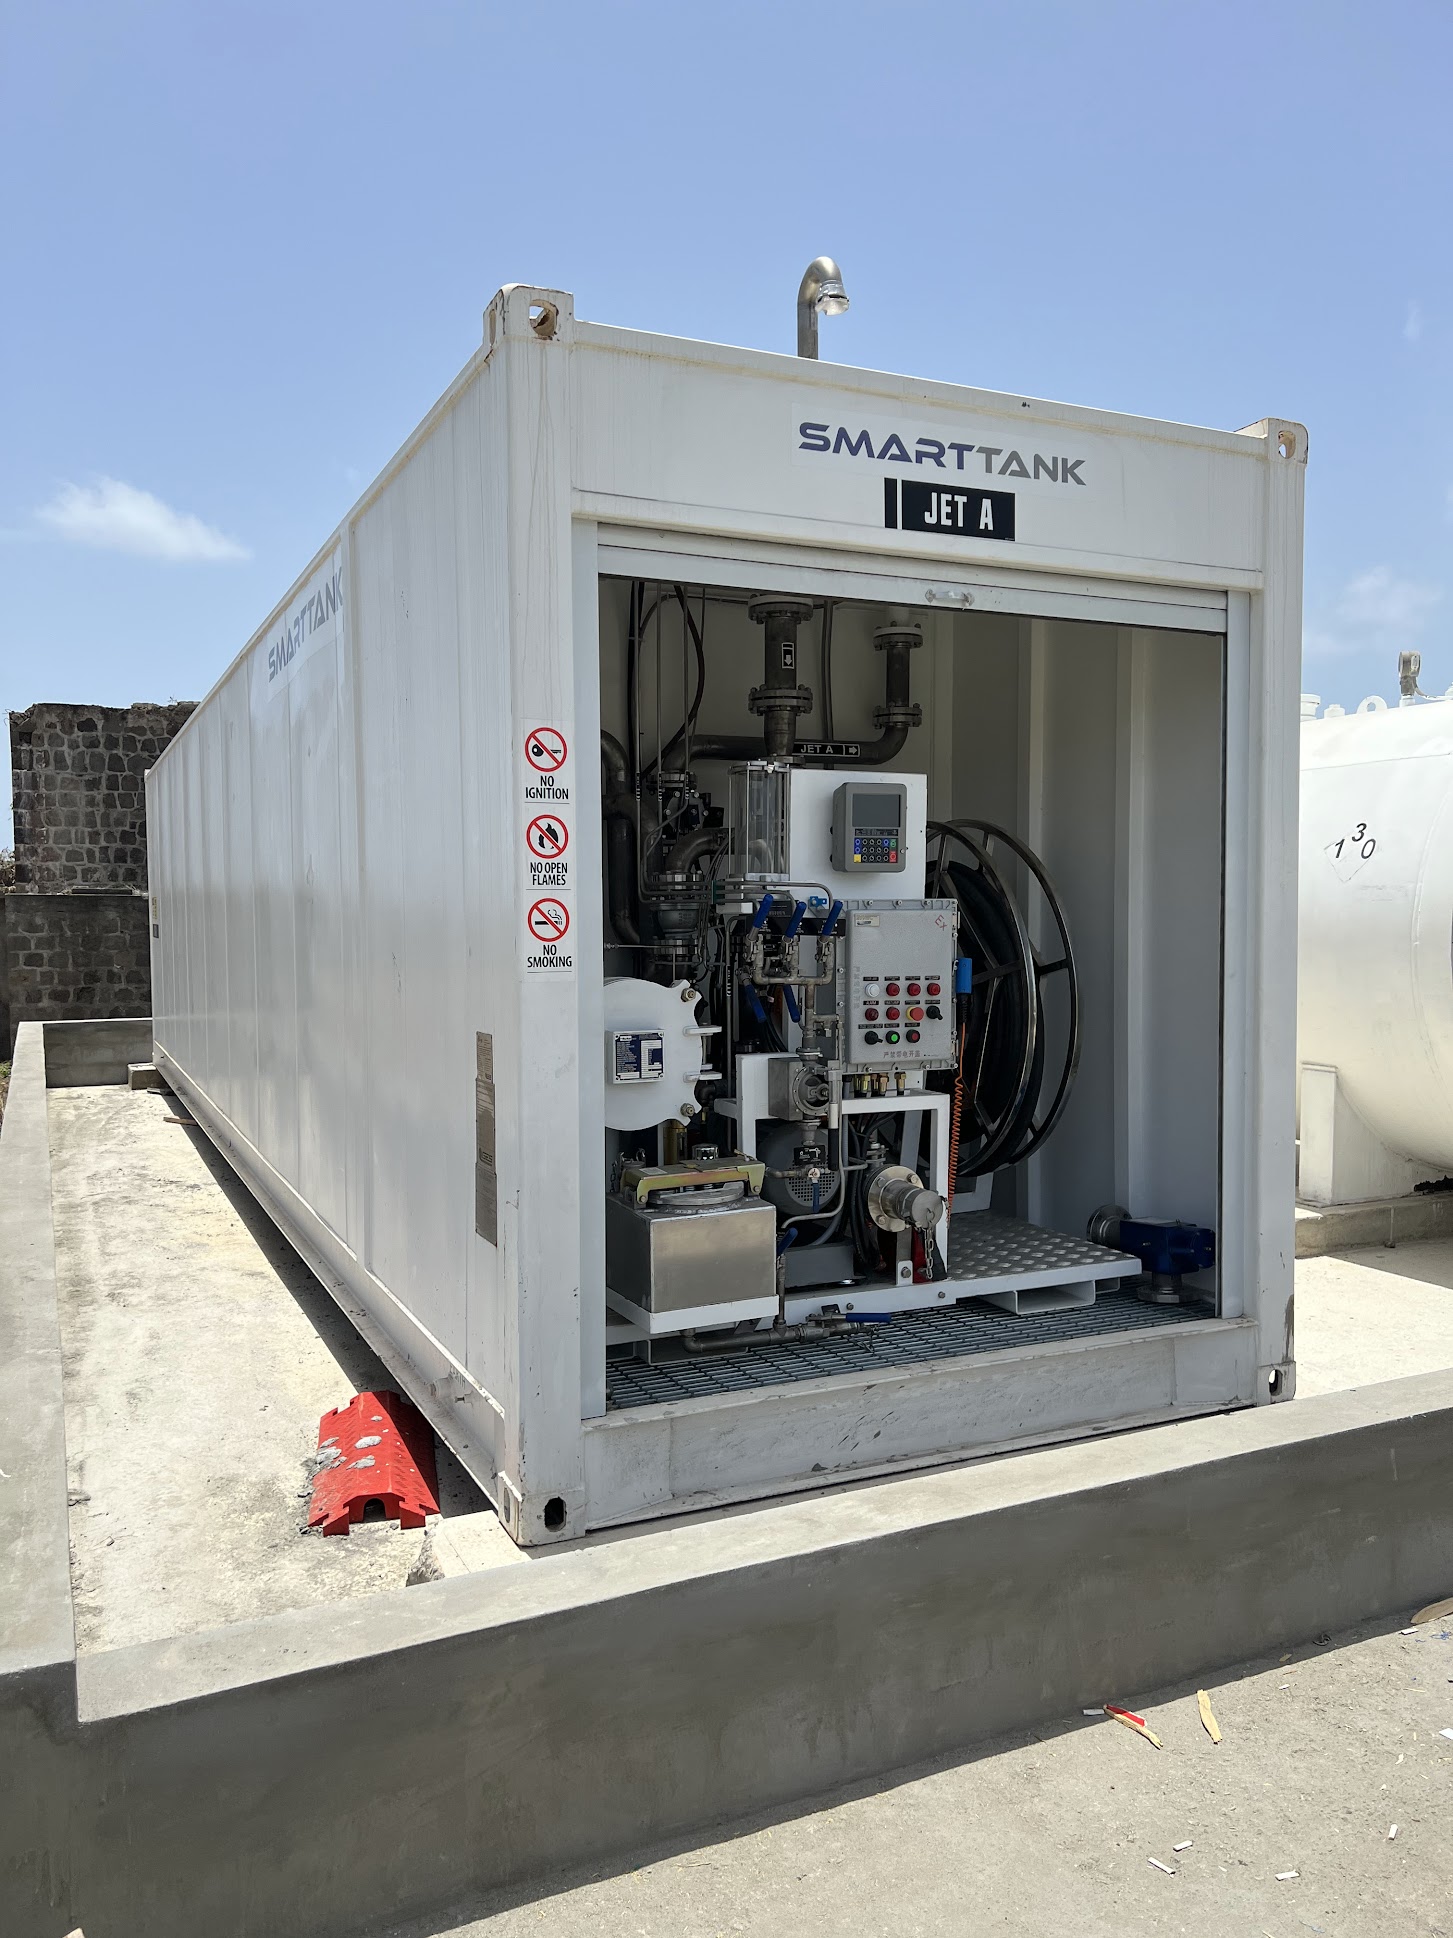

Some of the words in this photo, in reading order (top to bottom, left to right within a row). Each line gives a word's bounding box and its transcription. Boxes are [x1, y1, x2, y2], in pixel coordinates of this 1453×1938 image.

[798, 421, 1087, 486] SMARTTANK
[924, 491, 968, 528] JET
[979, 498, 994, 531] A
[268, 566, 344, 683] SMARTTANK
[800, 744, 822, 753] JET
[825, 745, 834, 754] A
[540, 775, 555, 787] NO
[525, 786, 570, 800] IGNITION
[1351, 822, 1368, 842] 3
[1334, 838, 1346, 859] 1
[1360, 838, 1377, 860] 0
[530, 862, 544, 874] NO
[544, 861, 568, 875] OPEN
[532, 873, 567, 886] FLAMES
[934, 914, 948, 931] Ex
[543, 944, 557, 956] NO
[527, 955, 573, 968] SMOKING
